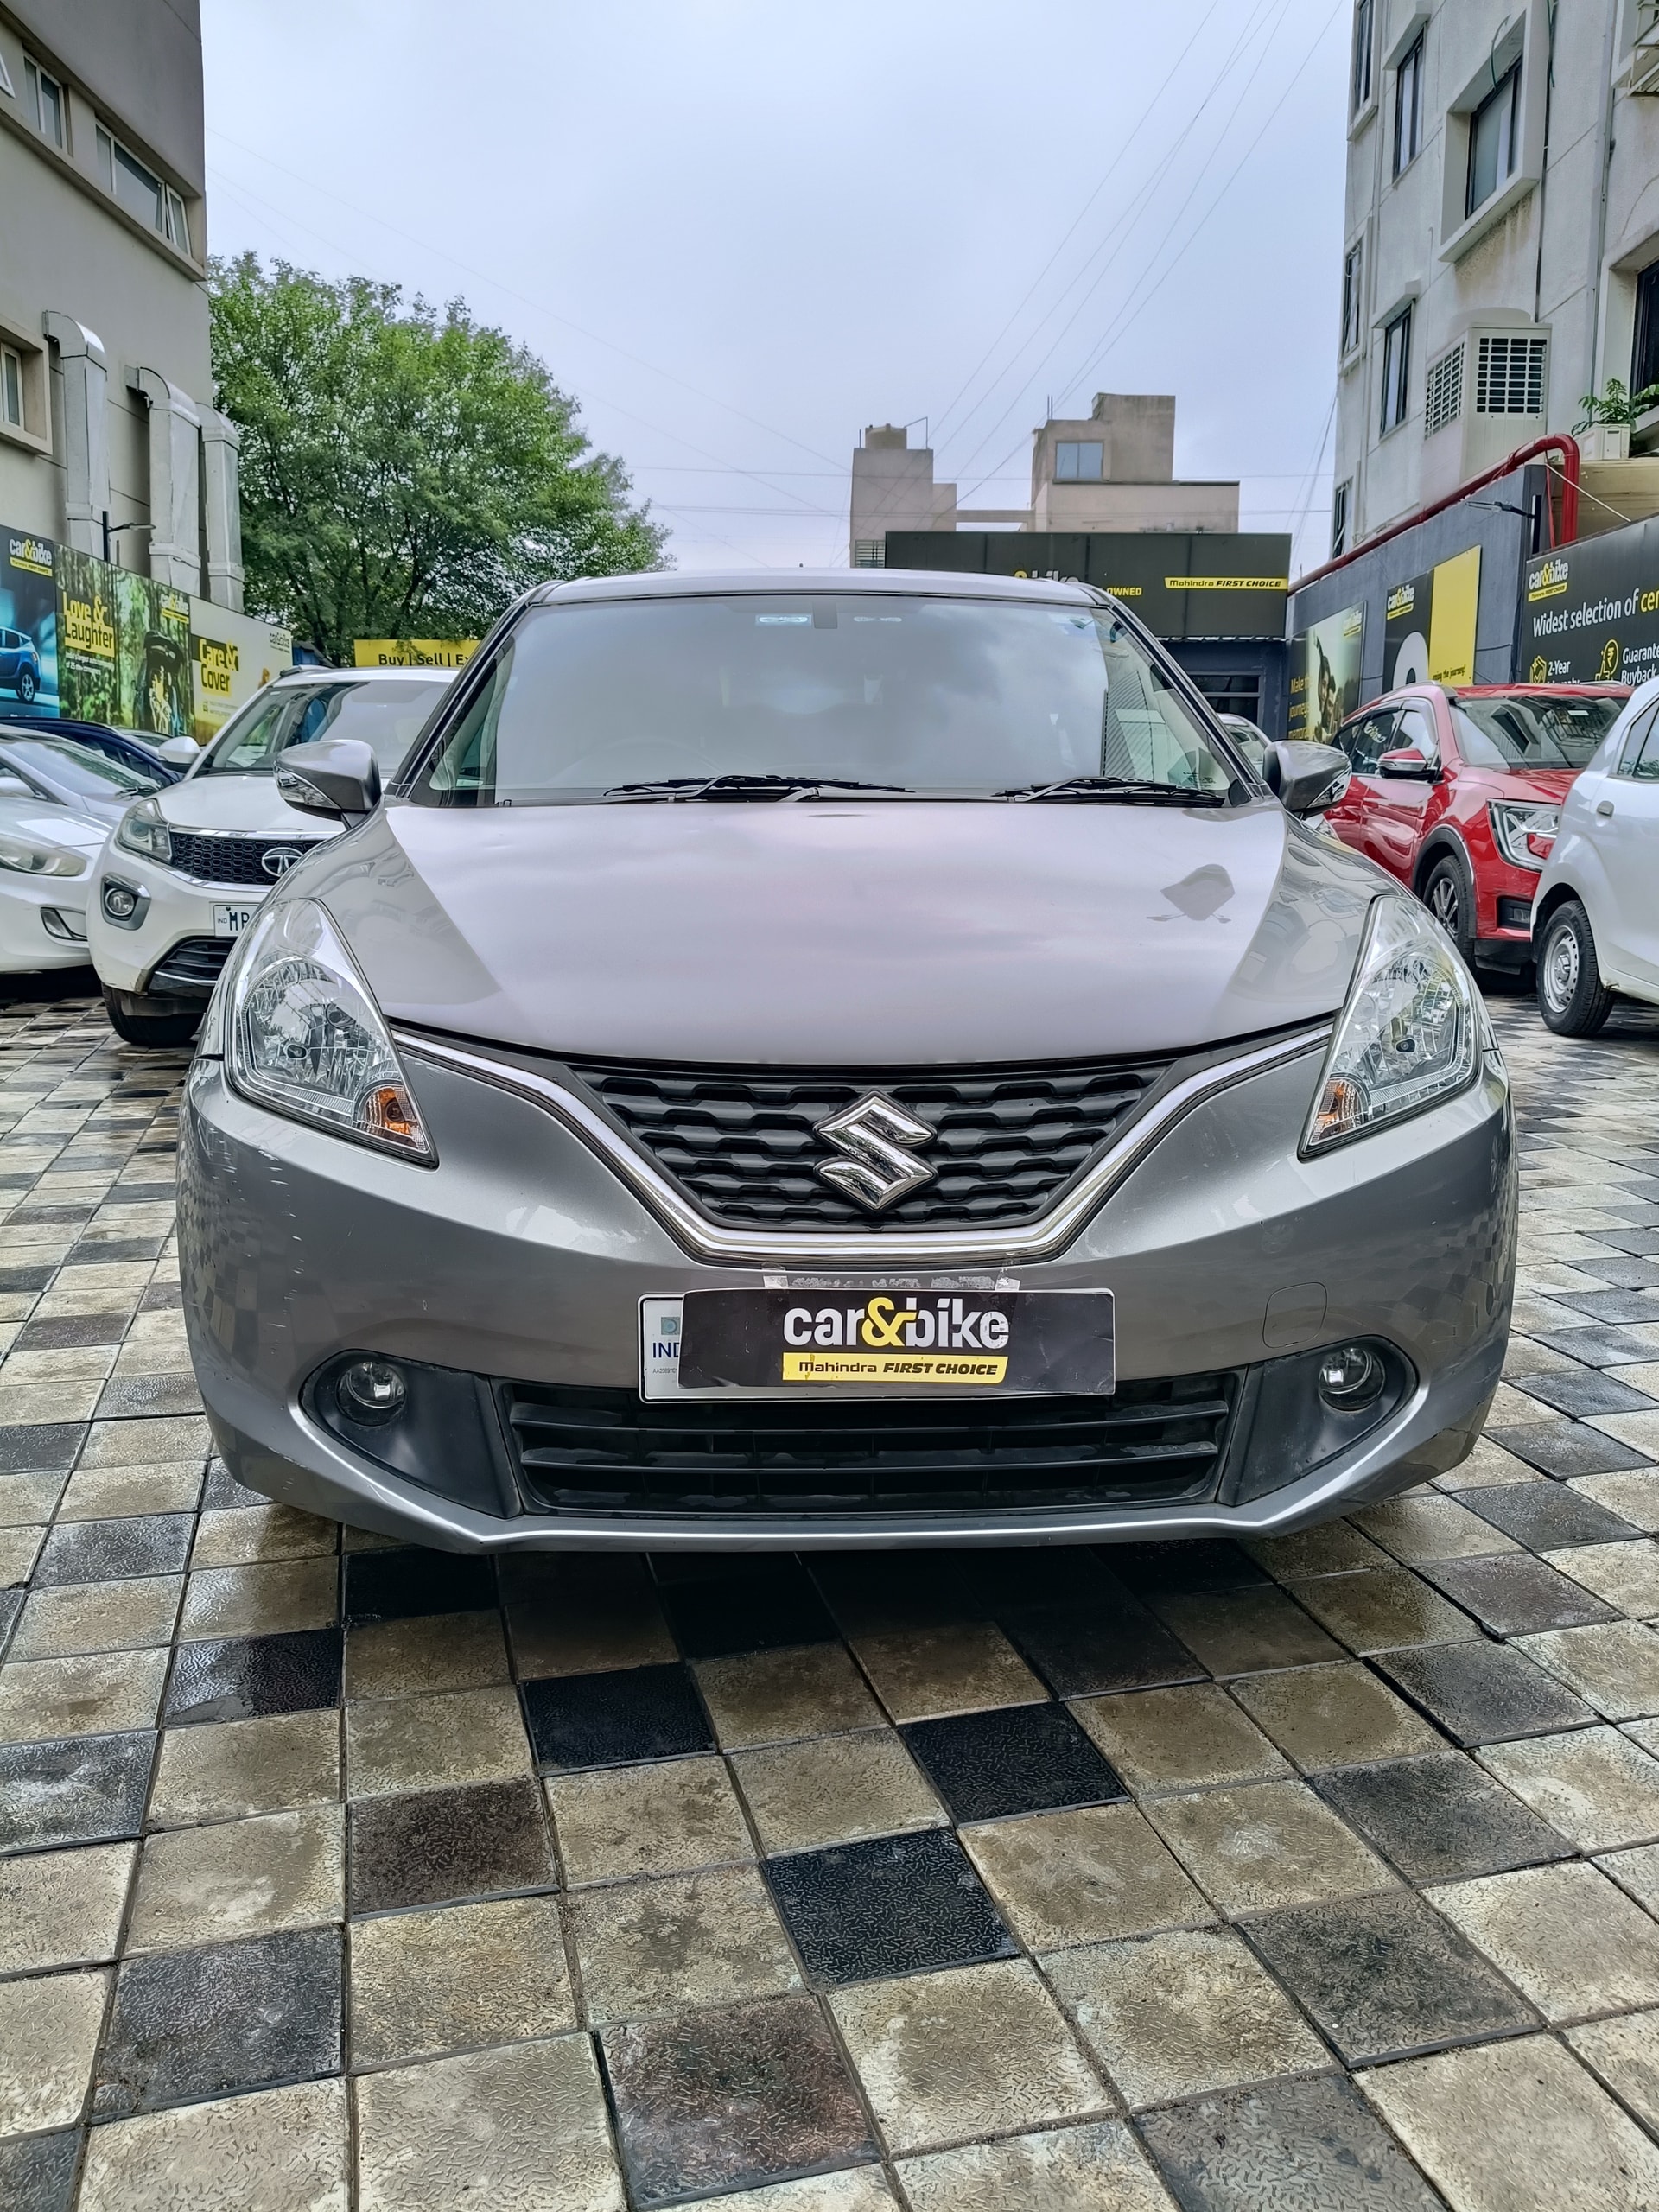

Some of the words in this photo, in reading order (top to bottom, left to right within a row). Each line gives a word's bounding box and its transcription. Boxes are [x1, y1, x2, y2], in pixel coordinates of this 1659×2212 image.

[9, 538, 52, 566] car&bike
[1529, 559, 1569, 590] car&bike
[1106, 587, 1142, 596] OWNED
[1387, 583, 1414, 611] car&bike
[63, 591, 92, 620] Love
[93, 594, 108, 625] &
[1533, 610, 1569, 638] Widest
[1570, 597, 1621, 630] selection
[1624, 588, 1640, 616] of
[65, 615, 113, 649] Laughter
[199, 639, 226, 668] Care
[226, 641, 238, 671] &
[378, 654, 404, 666] Buy
[417, 653, 443, 665] Sell
[1548, 659, 1571, 676] 2-Year
[200, 664, 230, 692] Cover
[1621, 663, 1657, 686] Buyback
[783, 1296, 1010, 1350] car&bike
[798, 1361, 877, 1373] Mahindra
[883, 1362, 933, 1374] FIRST
[935, 1363, 999, 1376] CHOICE
